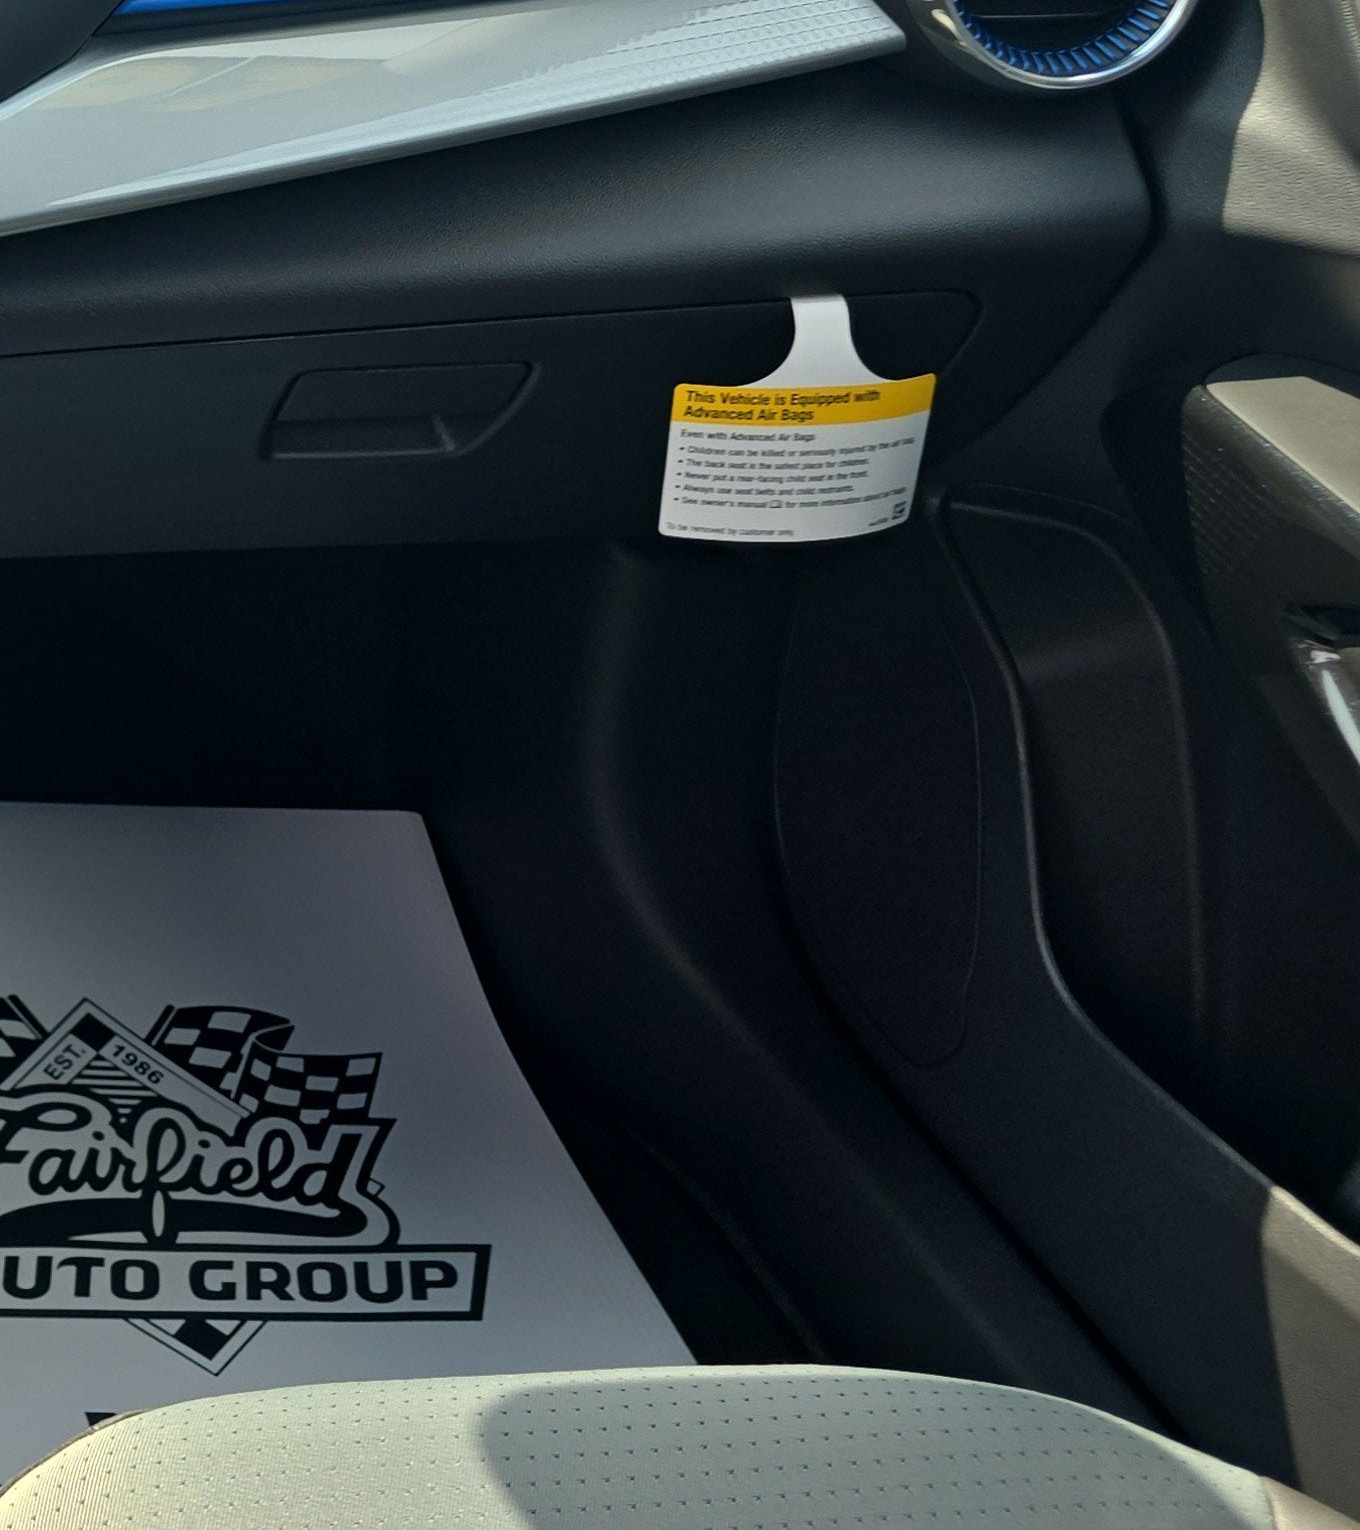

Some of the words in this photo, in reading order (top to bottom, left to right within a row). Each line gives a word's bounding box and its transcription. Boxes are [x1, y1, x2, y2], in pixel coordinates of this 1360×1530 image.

[683, 405, 754, 420] Advanced
[757, 408, 777, 421] Air
[781, 408, 815, 423] Bags
[685, 389, 716, 404] This
[720, 392, 771, 406] Vehicle
[774, 393, 787, 406] is
[790, 391, 852, 408] Equipped
[853, 389, 881, 403] with
[44, 1045, 88, 1082] EST.
[110, 1042, 166, 1086] 1986
[187, 1258, 460, 1304] GROUP
